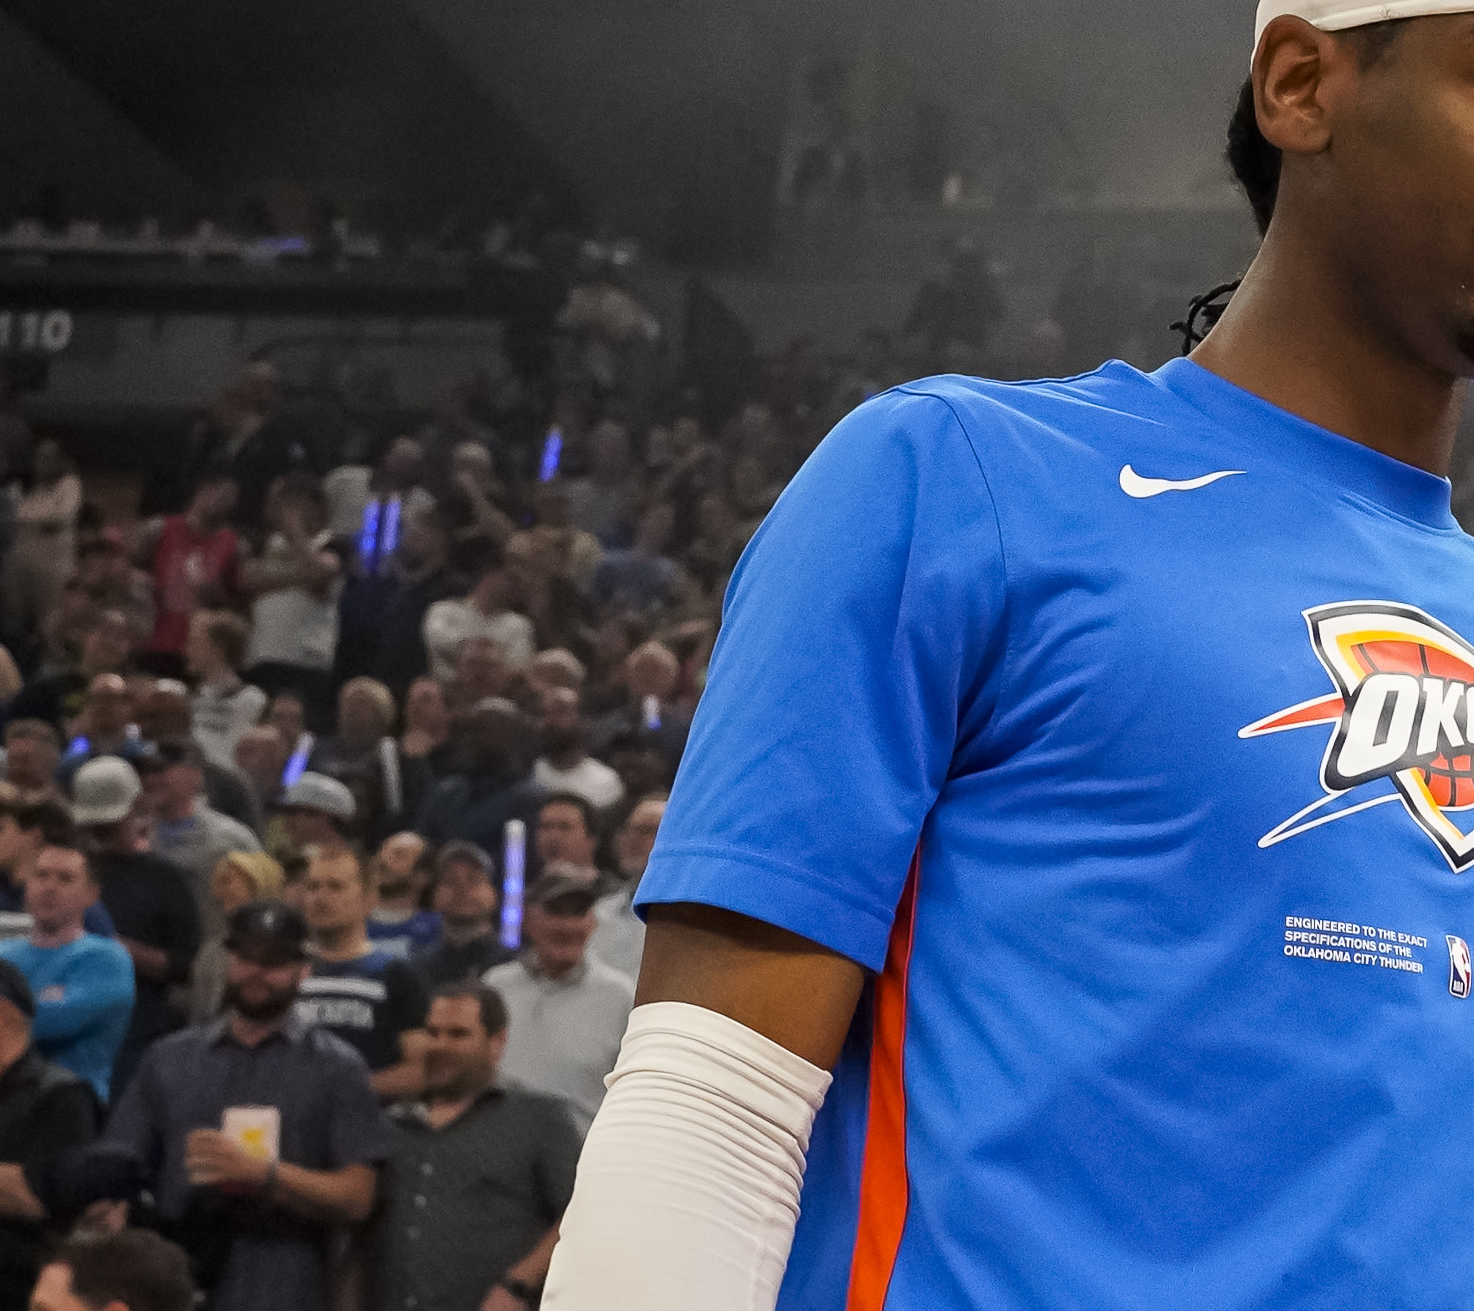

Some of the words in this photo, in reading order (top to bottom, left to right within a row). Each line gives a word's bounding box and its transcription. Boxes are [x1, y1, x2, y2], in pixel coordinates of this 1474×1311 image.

[1284, 930, 1377, 952] SPECIFICATIONS
[1378, 942, 1393, 954] OF
[1393, 945, 1413, 958] THE
[1285, 916, 1360, 935] ENGINEERED
[1361, 925, 1377, 938] TO
[1377, 928, 1397, 942] THE
[1397, 933, 1428, 948] EXACT
[1283, 944, 1352, 963] OKLAHOMA
[1353, 952, 1378, 966] CITY
[1379, 955, 1423, 974] THUNDER
